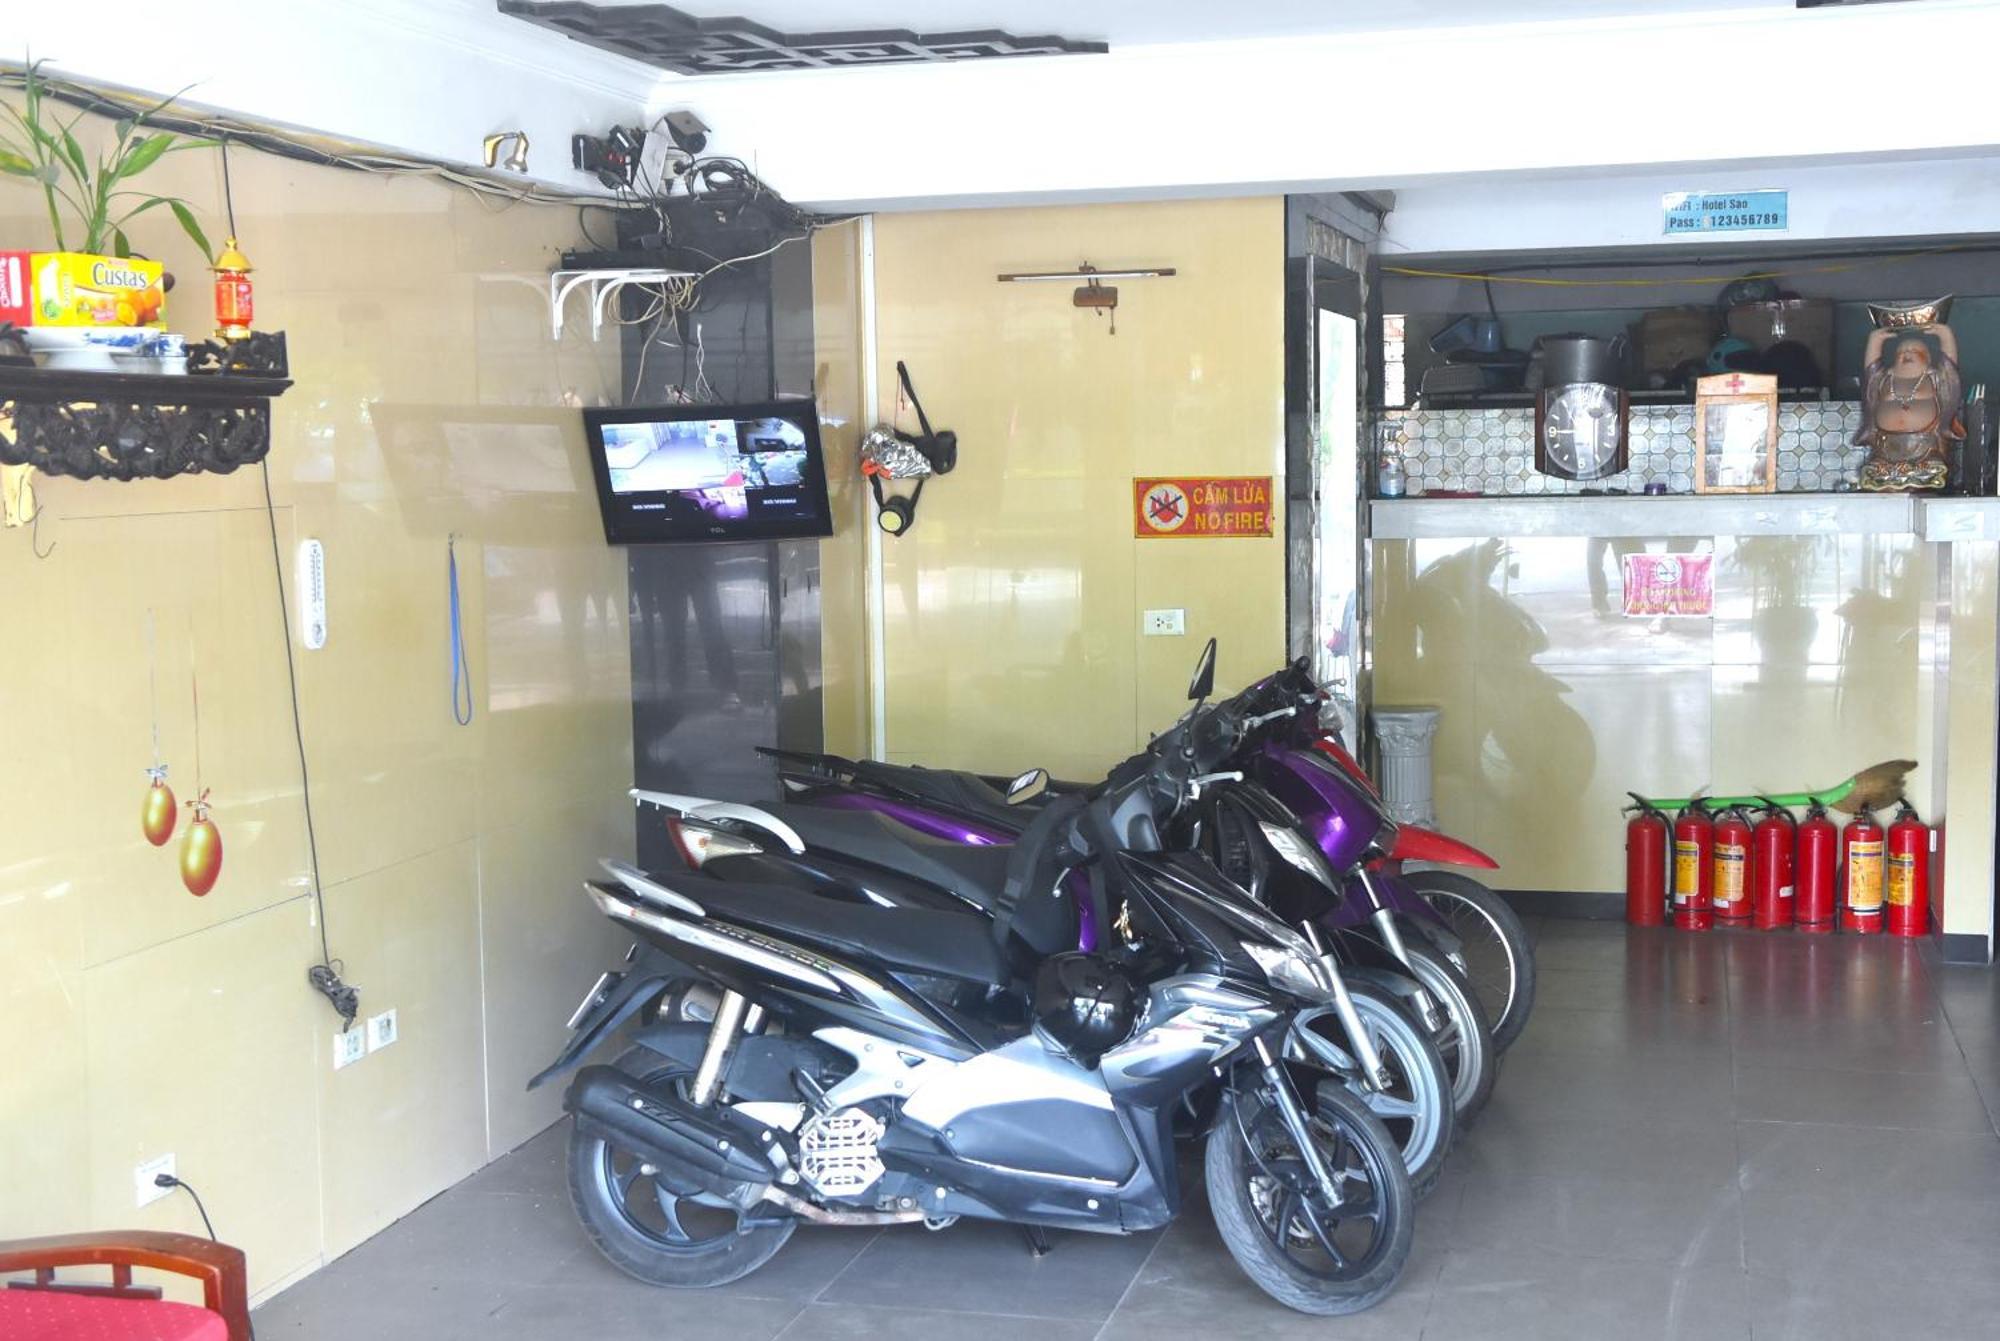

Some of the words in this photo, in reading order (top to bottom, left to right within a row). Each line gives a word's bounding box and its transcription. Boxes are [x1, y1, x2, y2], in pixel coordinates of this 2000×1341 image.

[1702, 199, 1726, 211] Hotel
[1729, 199, 1748, 209] Sao
[1711, 213, 1778, 226] 123456789
[92, 262, 147, 288] Custas
[1195, 511, 1221, 530] NO
[1224, 511, 1264, 530] FIRE
